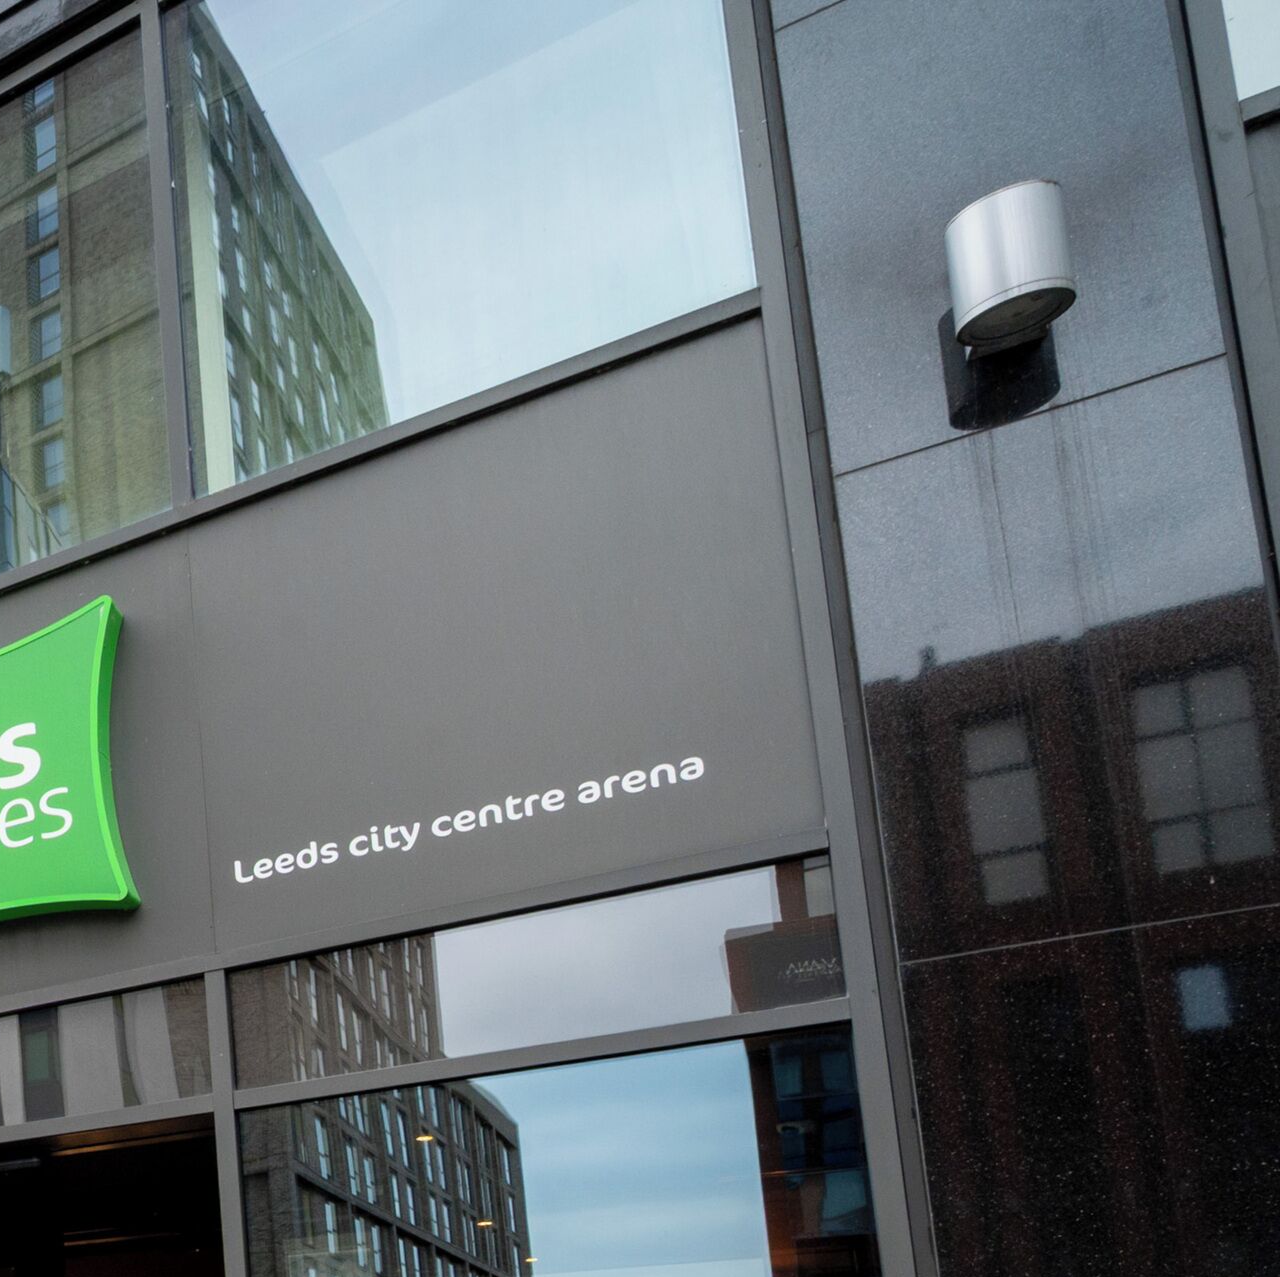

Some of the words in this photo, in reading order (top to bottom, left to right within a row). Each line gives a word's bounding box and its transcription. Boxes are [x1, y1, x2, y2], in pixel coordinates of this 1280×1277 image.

[233, 840, 339, 885] Leeds
[348, 821, 421, 859] city
[430, 787, 566, 838] centre
[577, 755, 705, 804] arena
